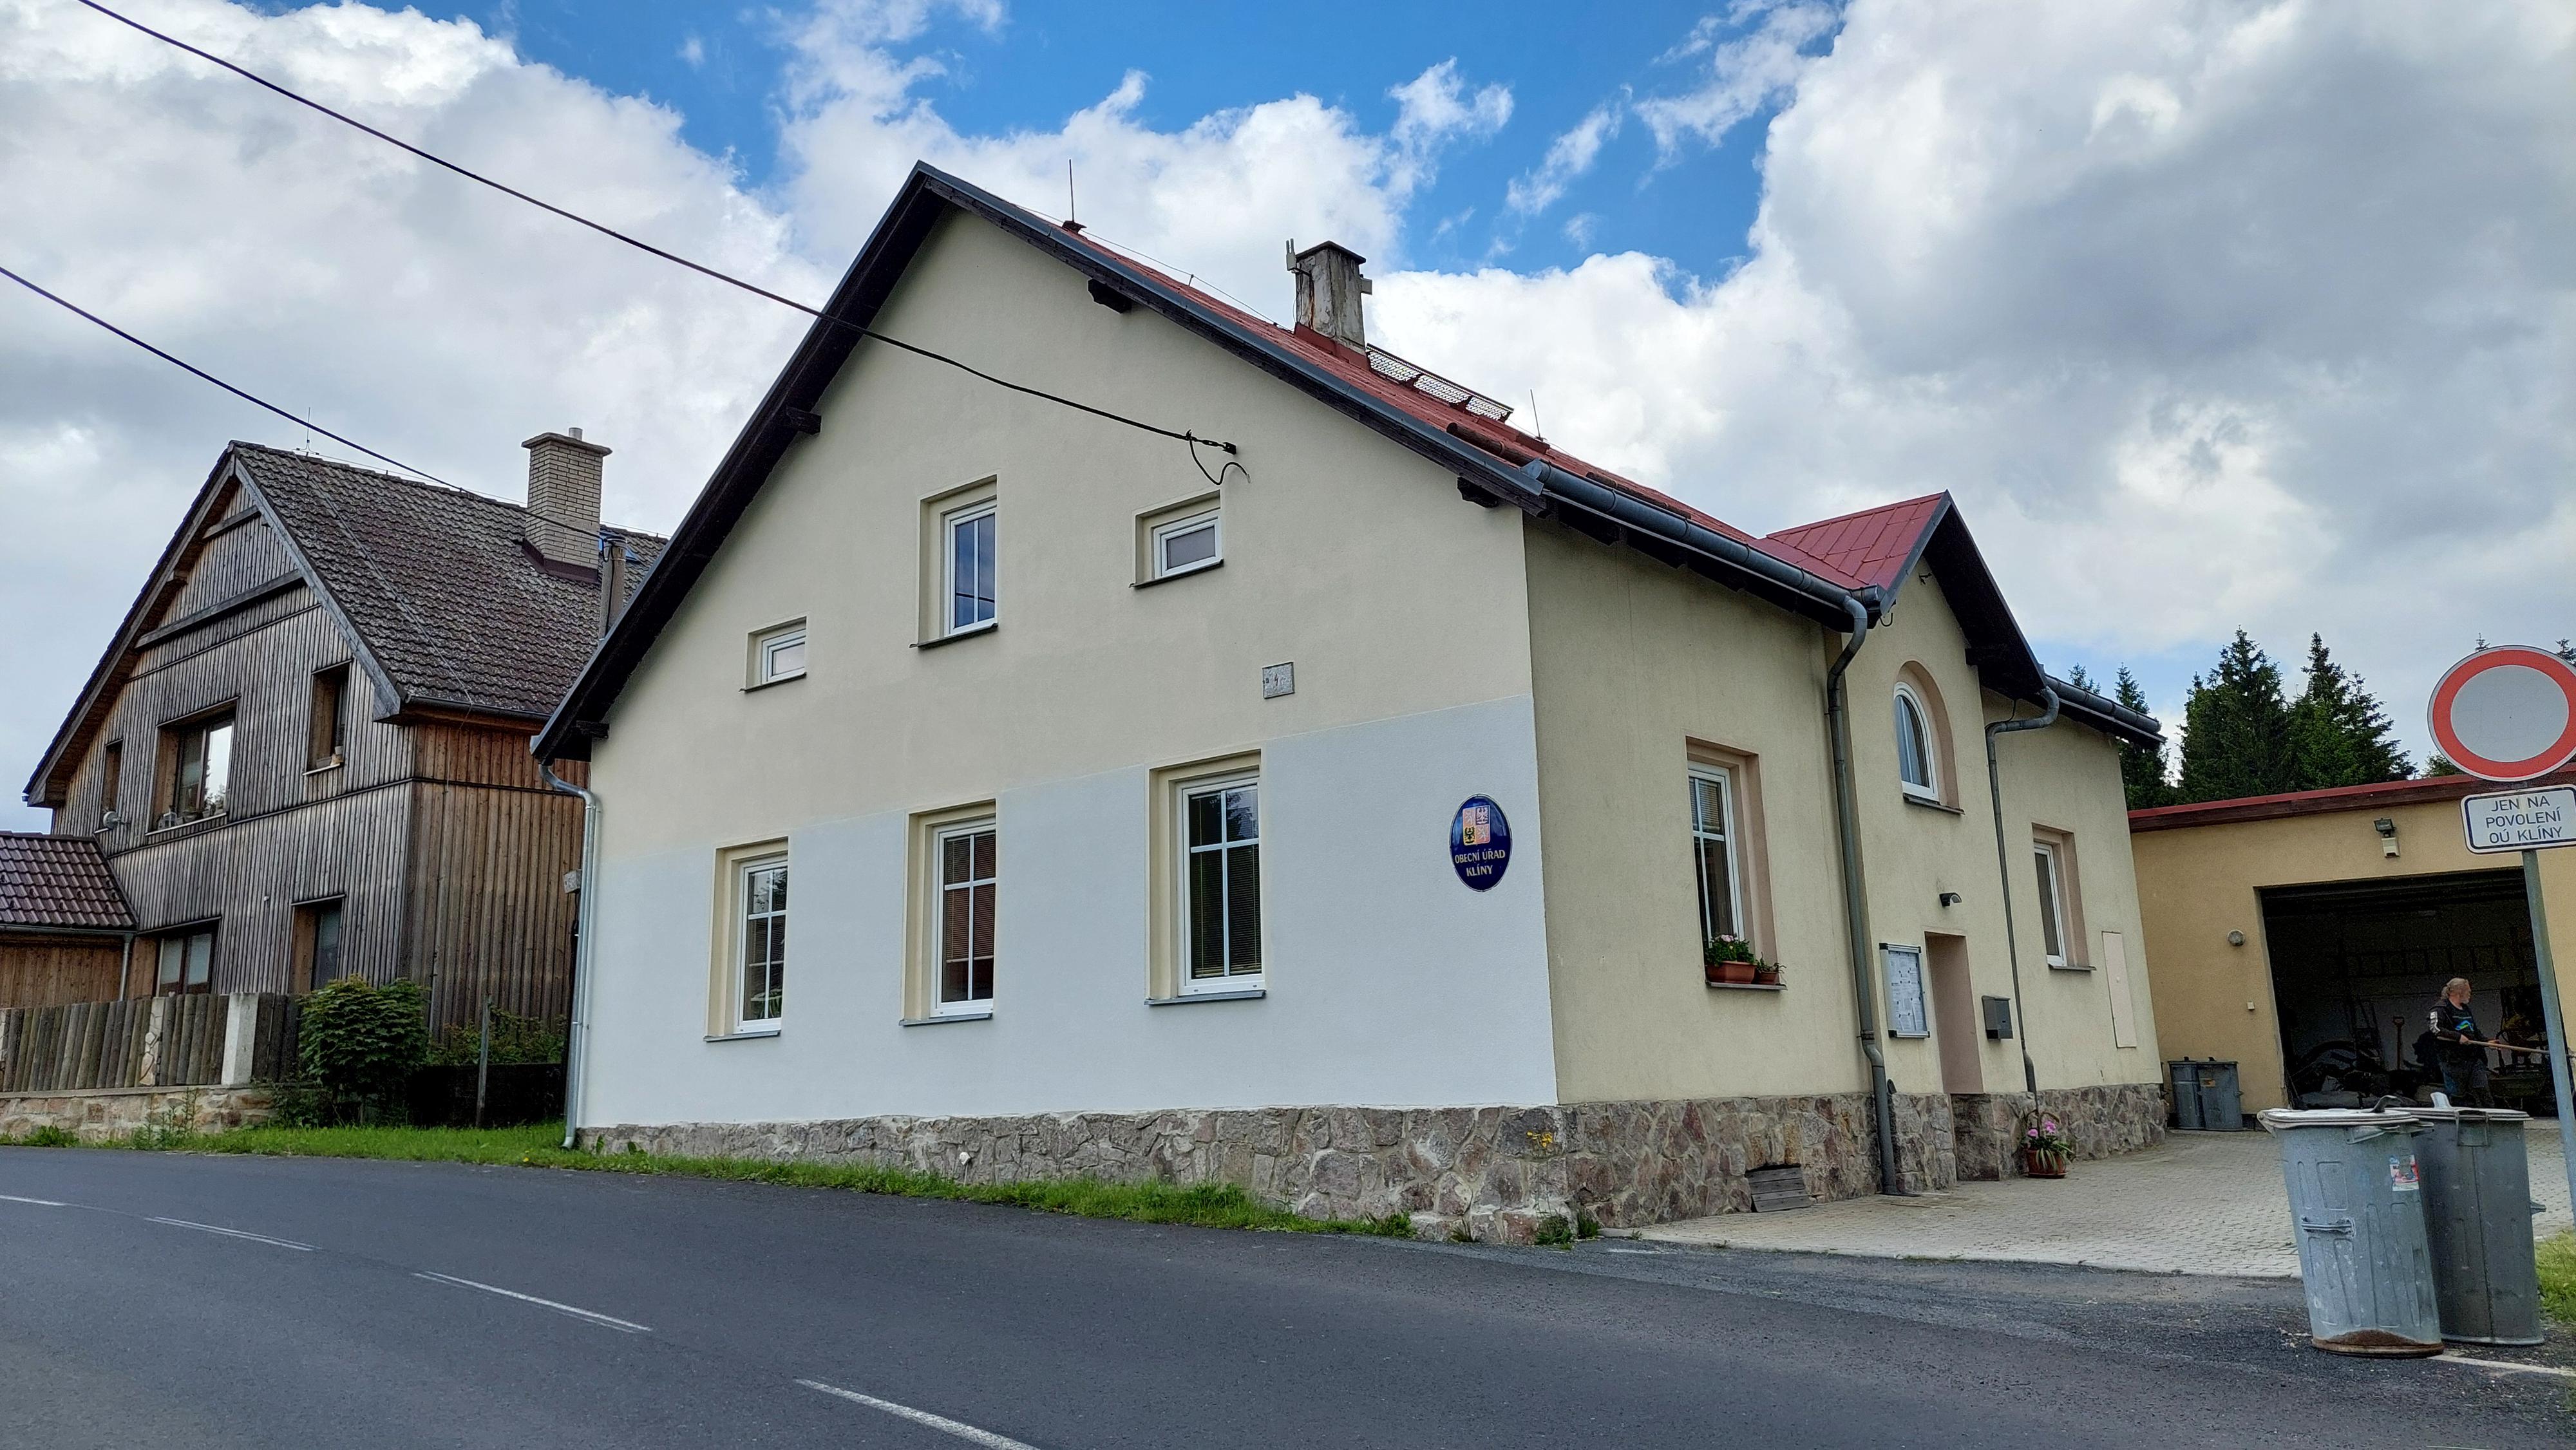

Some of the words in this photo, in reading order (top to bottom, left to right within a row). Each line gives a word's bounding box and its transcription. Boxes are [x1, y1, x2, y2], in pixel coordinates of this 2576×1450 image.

[2491, 798, 2520, 811] JEN
[2527, 795, 2550, 808] NA
[2486, 806, 2561, 828] POVOLENÍ
[2489, 828, 2510, 843] OÚ
[2517, 825, 2562, 842] KLÍNY
[1455, 849, 1480, 863] OBECNÍ
[1482, 848, 1505, 860] ÚŘAD
[1466, 863, 1493, 876] KLÍNY
